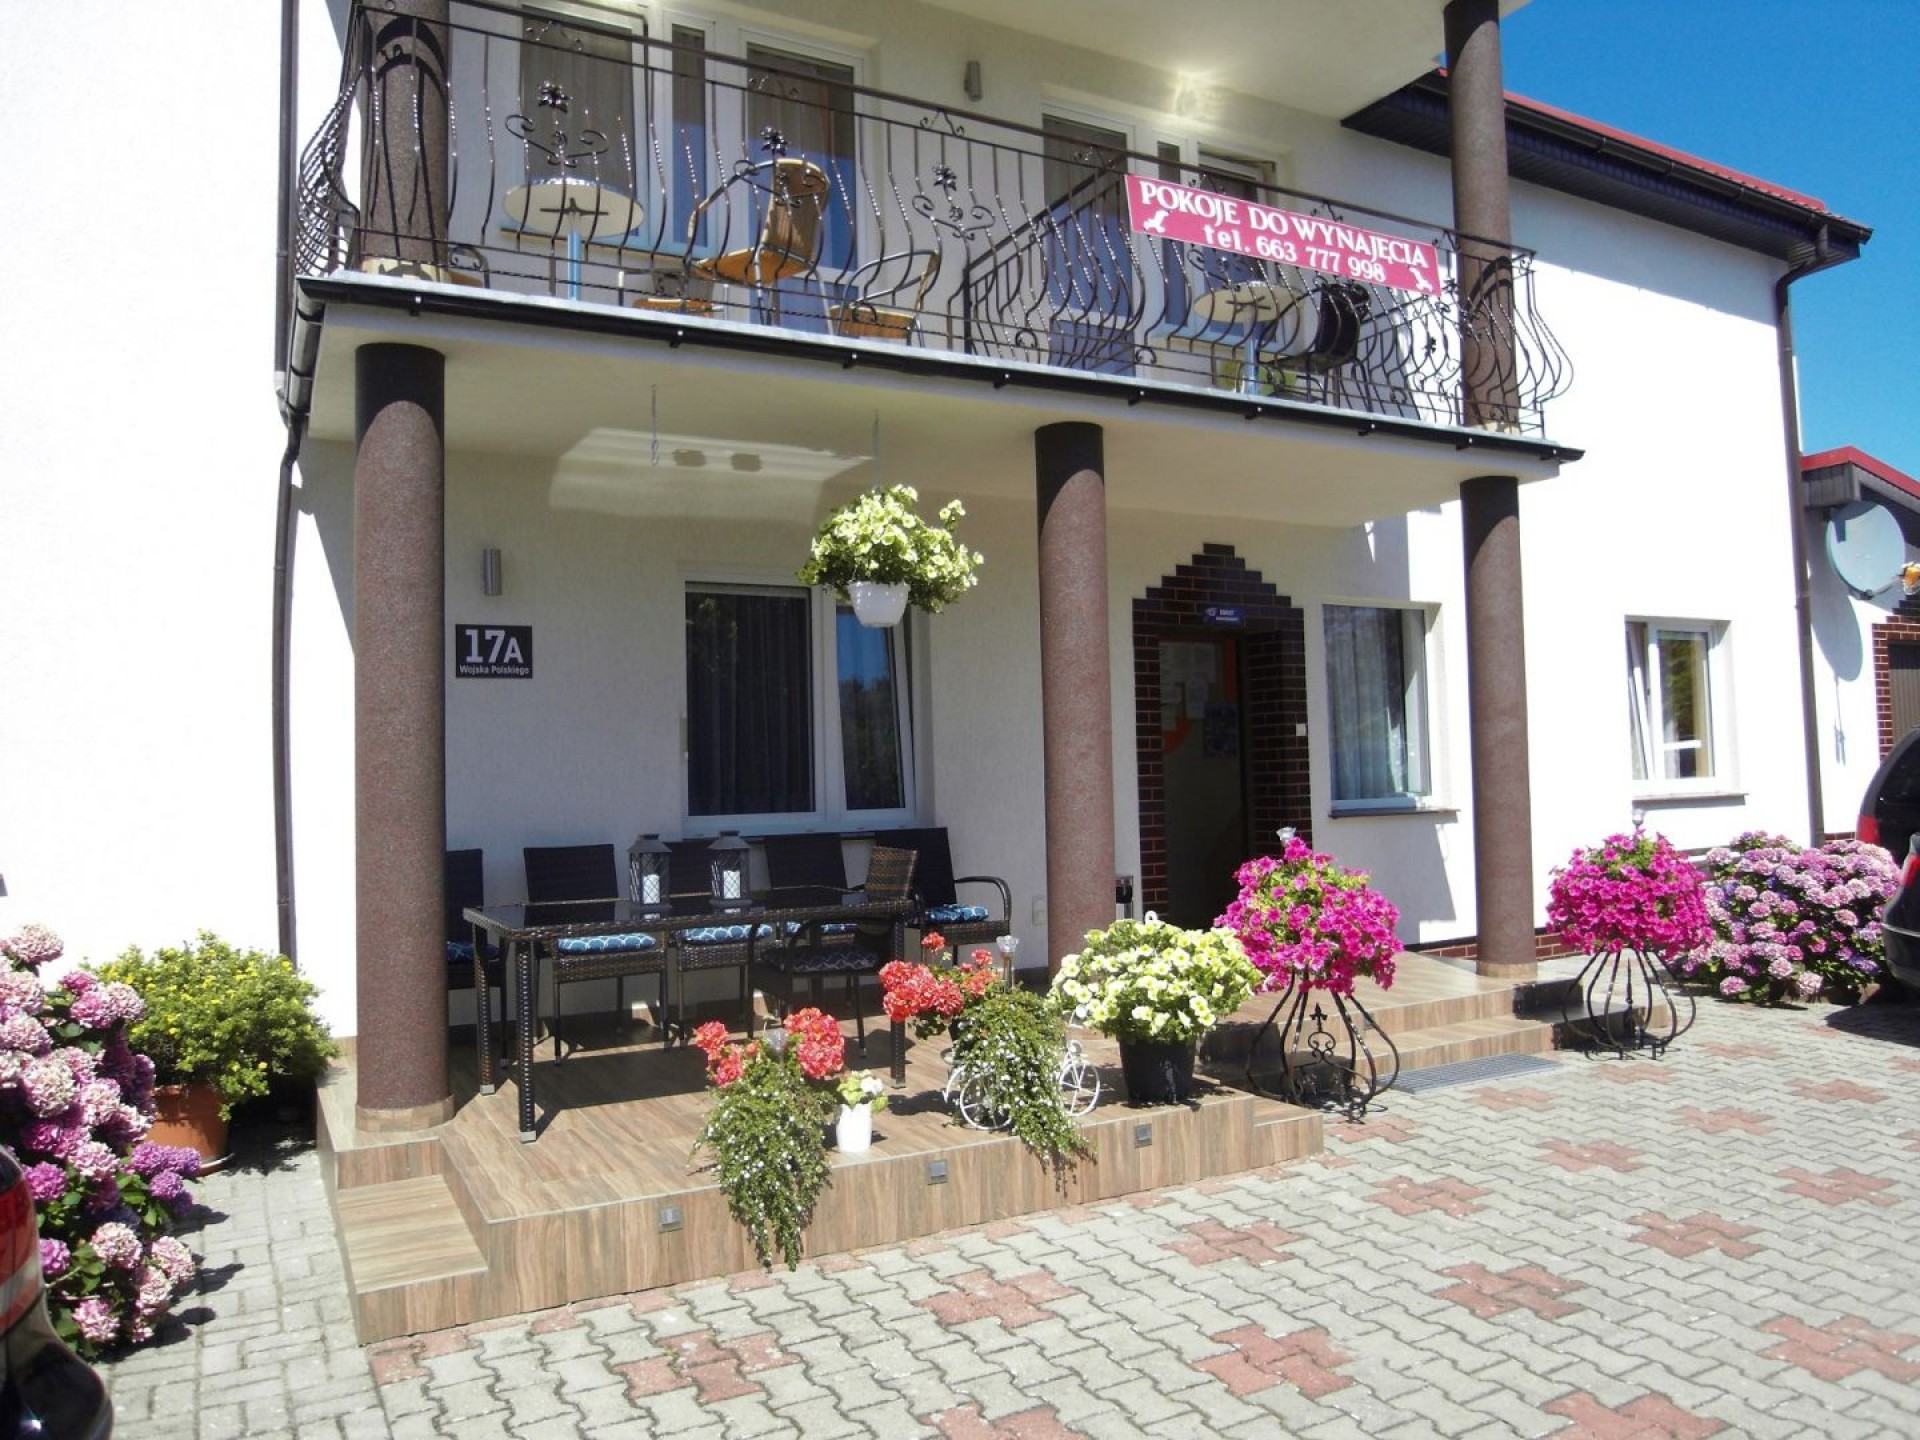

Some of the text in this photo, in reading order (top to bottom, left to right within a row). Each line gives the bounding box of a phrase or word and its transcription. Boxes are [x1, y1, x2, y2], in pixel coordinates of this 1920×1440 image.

[1139, 180, 1428, 268] POKOJE DO WYNAJĘCIA
[1204, 225, 1386, 282] tel. 663 777 998
[465, 628, 524, 663] 17A
[459, 664, 529, 676] Wojska Polskiego
